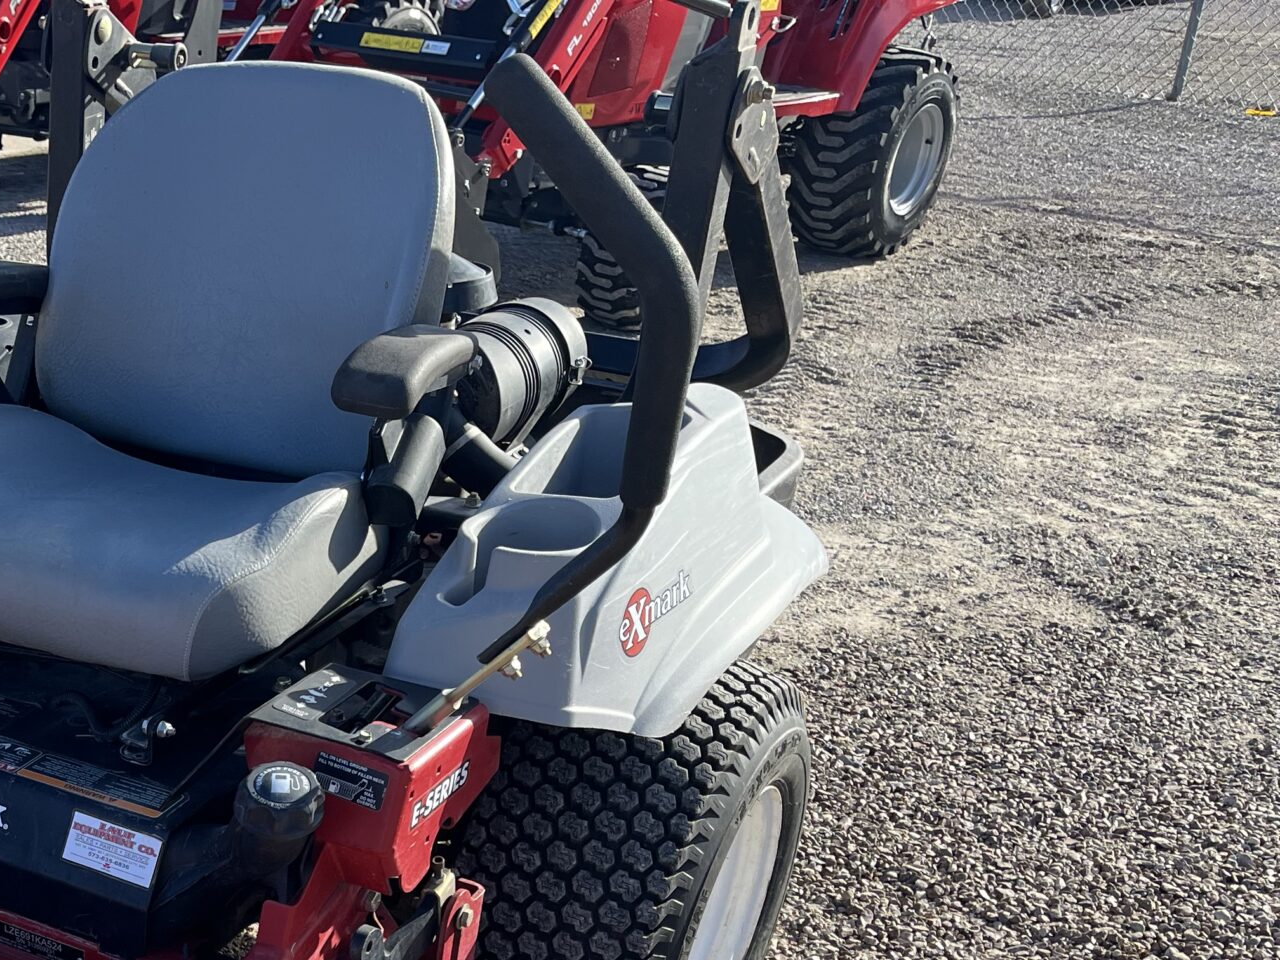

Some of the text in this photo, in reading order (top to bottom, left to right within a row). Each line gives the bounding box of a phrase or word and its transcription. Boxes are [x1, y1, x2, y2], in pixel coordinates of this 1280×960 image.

[567, 33, 583, 56] FL
[619, 569, 692, 650] eXmark
[333, 763, 351, 773] BOTTOM
[409, 762, 470, 830] E-SERIES
